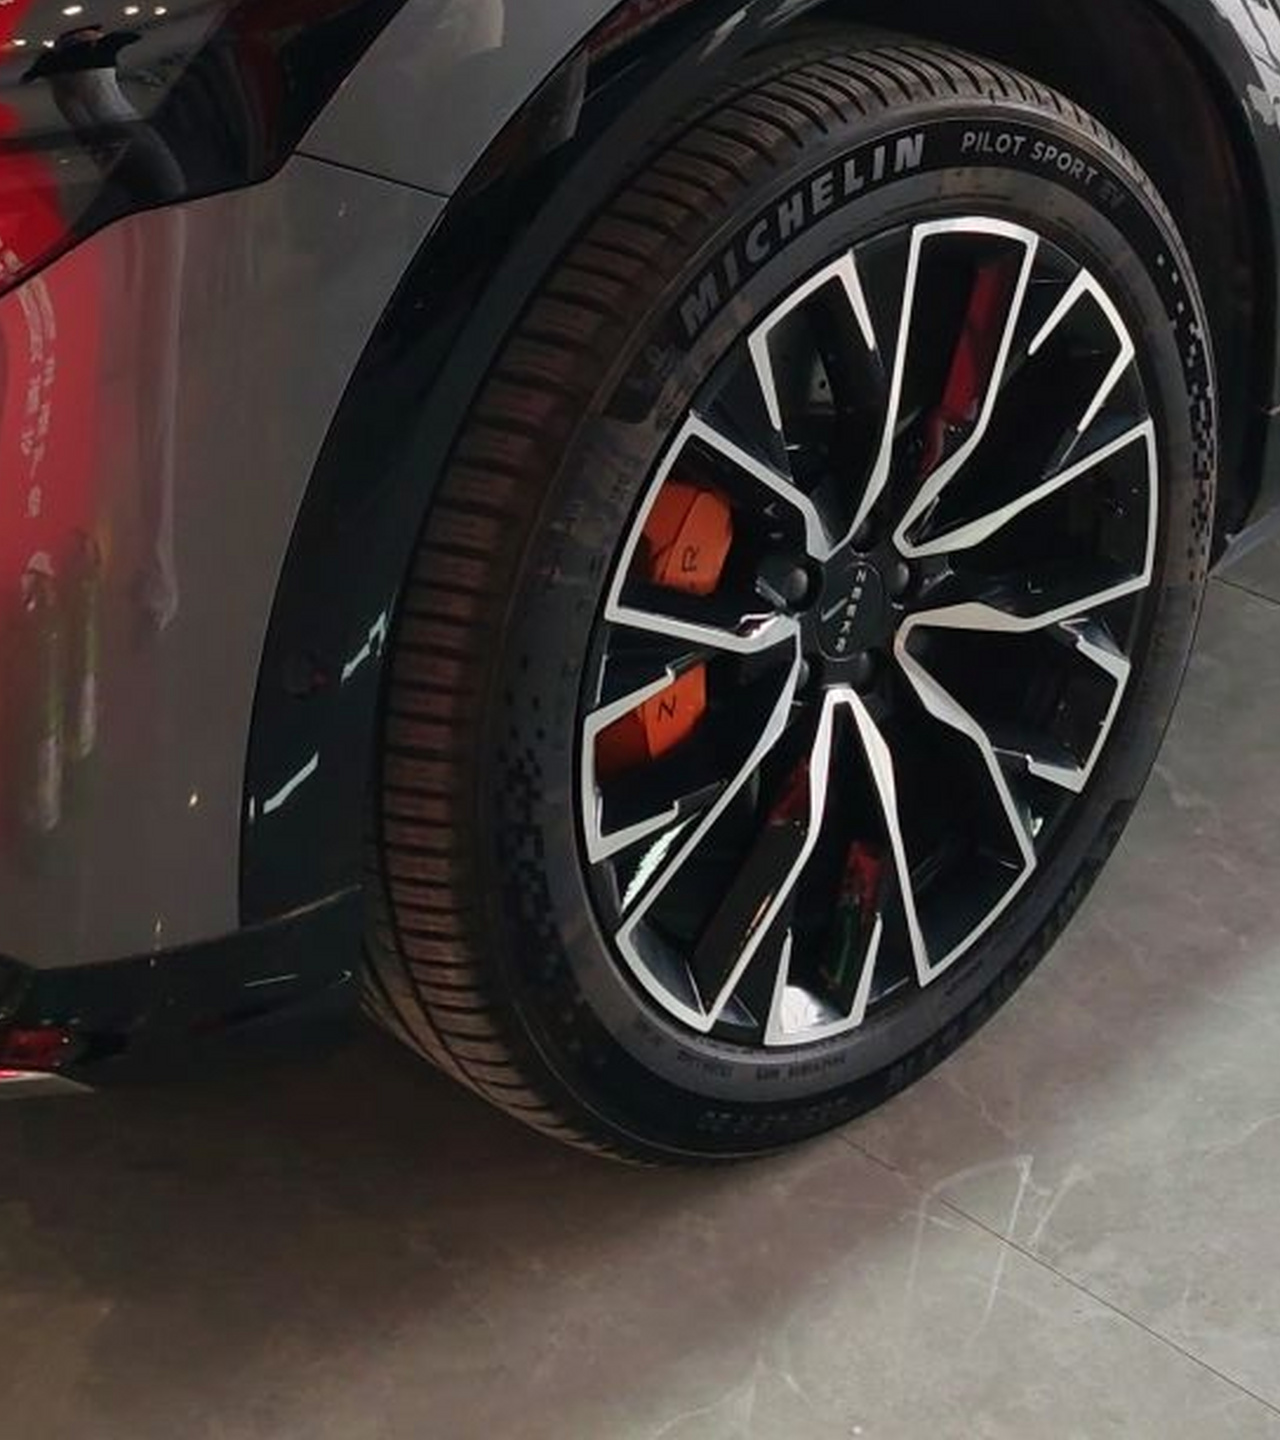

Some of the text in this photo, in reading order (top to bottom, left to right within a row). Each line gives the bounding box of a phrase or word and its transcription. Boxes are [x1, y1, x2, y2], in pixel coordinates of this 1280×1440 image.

[679, 133, 925, 338] MICHELIN
[960, 130, 1027, 158] PILOT
[1030, 140, 1099, 186] SPORT
